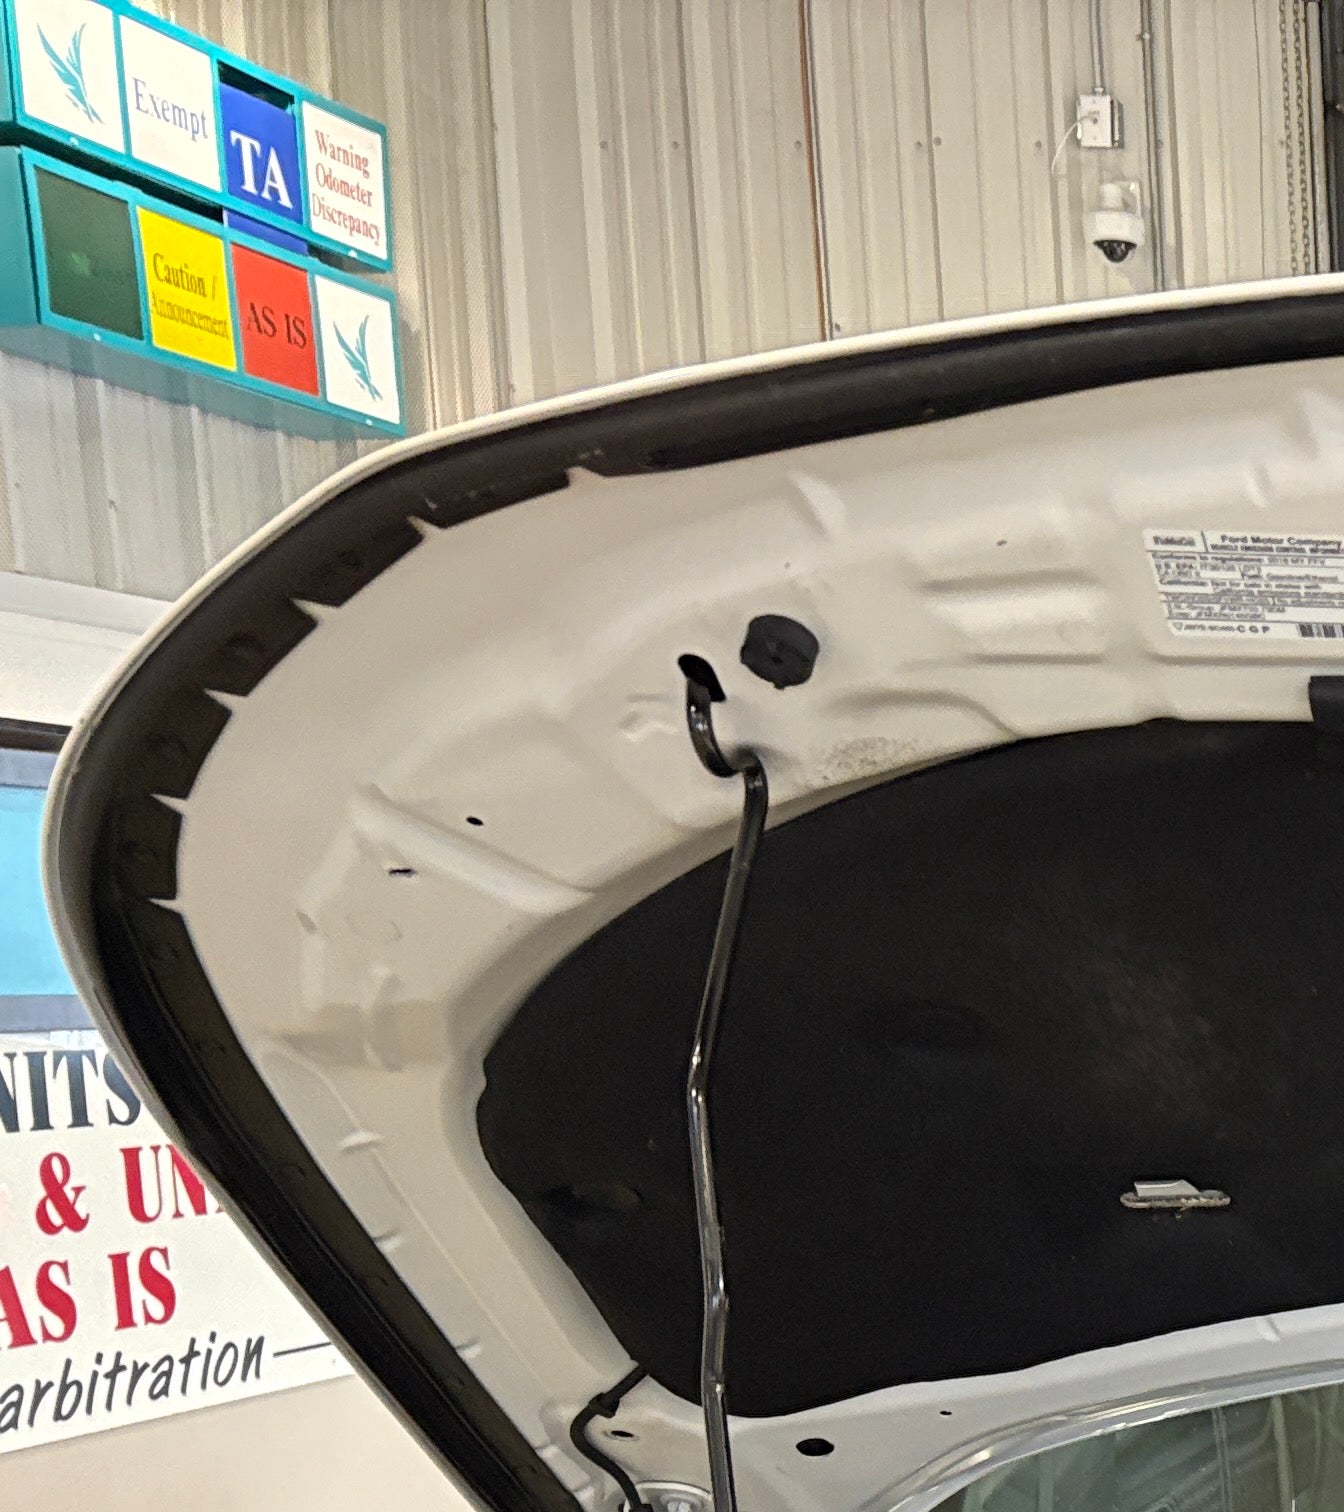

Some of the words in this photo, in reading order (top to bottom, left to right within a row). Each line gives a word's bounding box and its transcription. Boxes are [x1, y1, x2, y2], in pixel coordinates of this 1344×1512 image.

[132, 77, 208, 142] Exempt
[230, 129, 293, 210] TA
[314, 129, 371, 180] Warning
[315, 162, 373, 207] Odometer
[311, 192, 381, 247] Discrepancy
[152, 252, 207, 298] Caution
[150, 290, 231, 340] Announcement
[247, 302, 277, 338] AS
[284, 313, 307, 349] IS
[1220, 534, 1248, 544] Ford
[1250, 536, 1284, 545] Motor
[1286, 537, 1342, 552] Company
[35, 1152, 90, 1236] &
[119, 1143, 225, 1223] UN
[0, 1259, 77, 1349] AS
[107, 1246, 176, 1332] IS
[0, 1330, 265, 1435] arbitration
